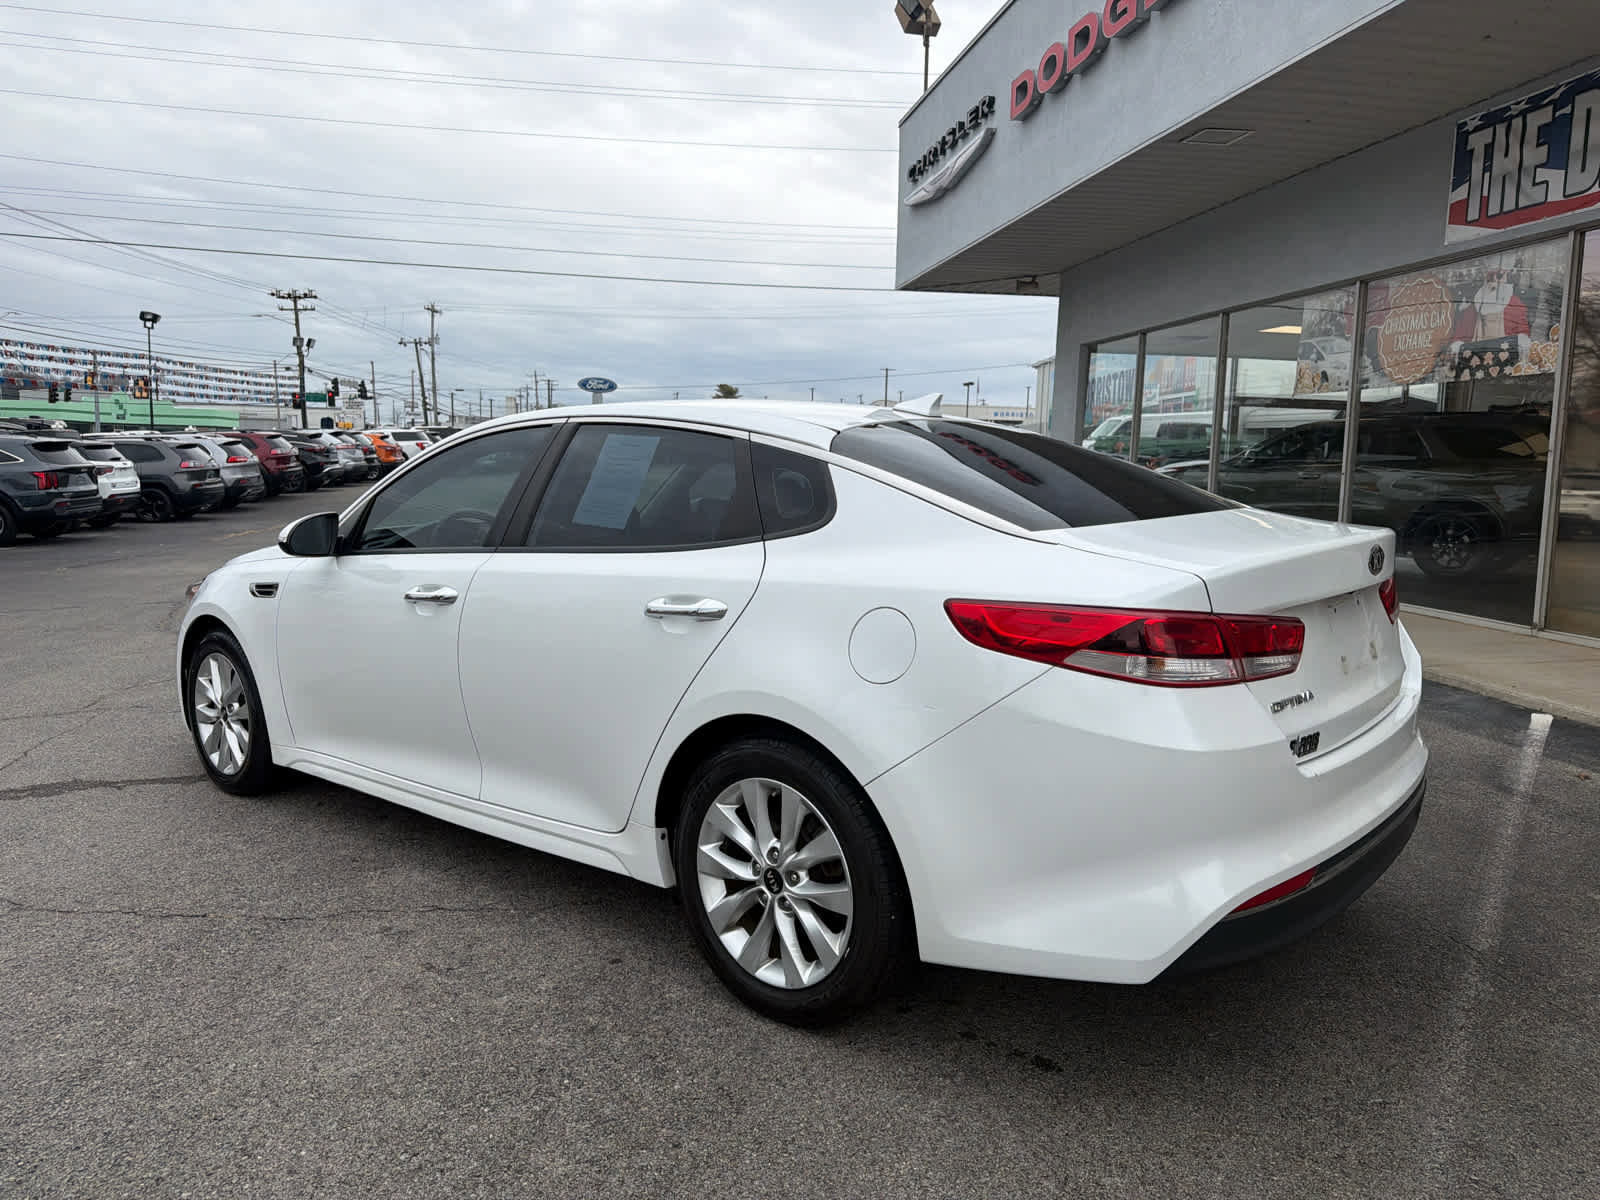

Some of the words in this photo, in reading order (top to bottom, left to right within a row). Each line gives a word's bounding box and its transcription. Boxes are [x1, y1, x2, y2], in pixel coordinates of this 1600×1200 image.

[1010, 0, 1160, 120] DODG
[1465, 104, 1555, 224] THE
[1385, 312, 1428, 335] CHRISTMAS
[1430, 309, 1446, 329] CAR
[1393, 331, 1433, 352] EXCHANGE
[586, 379, 609, 390] Ford
[1270, 690, 1314, 713] OPTIMA
